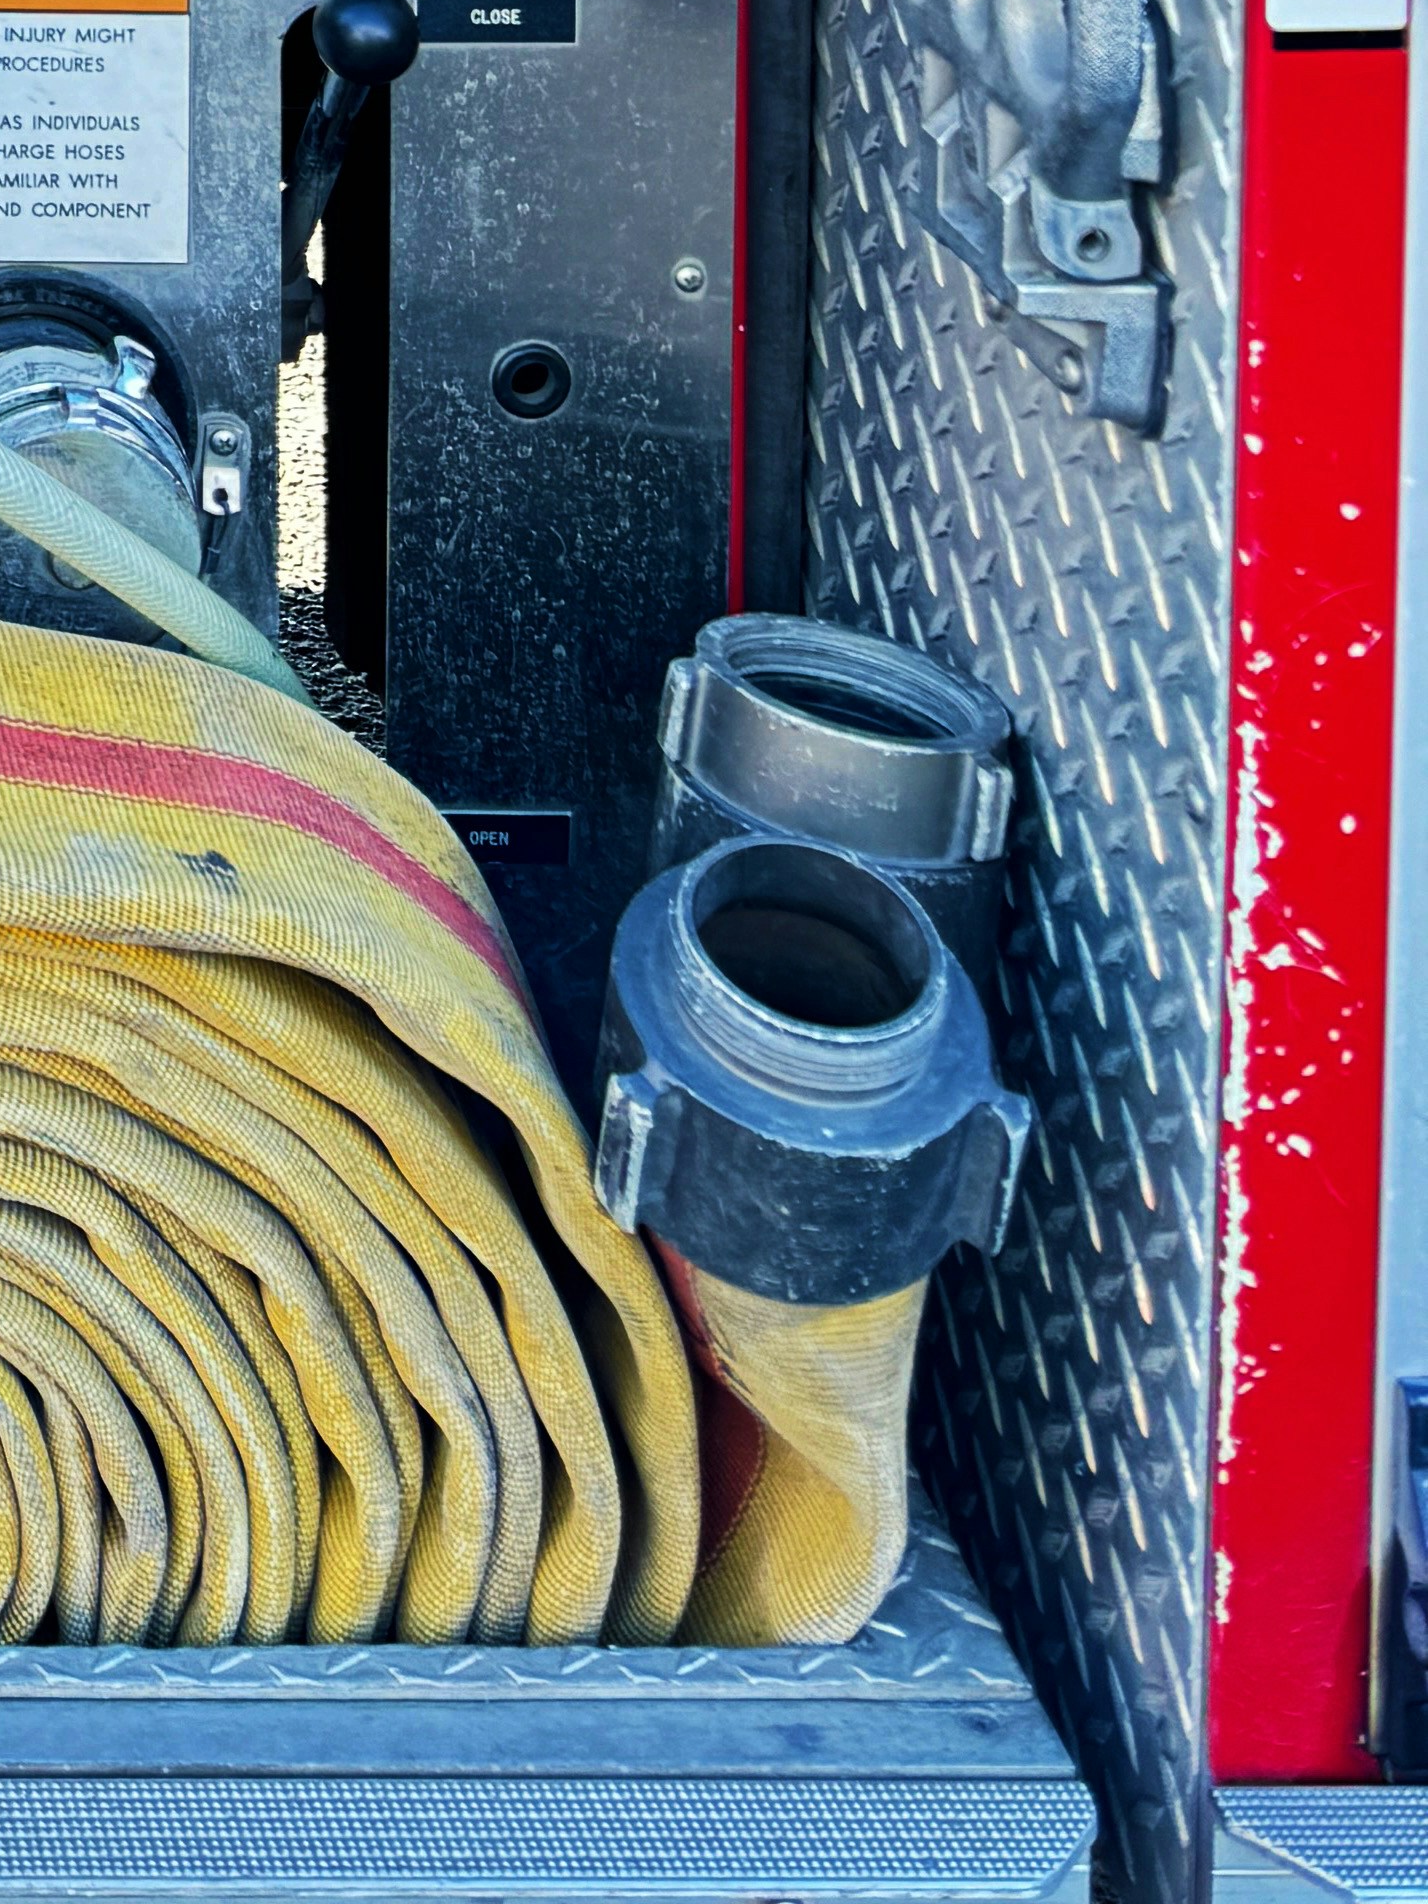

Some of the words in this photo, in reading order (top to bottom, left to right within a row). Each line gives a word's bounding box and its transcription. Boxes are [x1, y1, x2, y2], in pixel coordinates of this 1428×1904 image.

[470, 9, 521, 24] CLOSE
[4, 26, 65, 42] INJURY
[75, 27, 136, 43] MIGHT
[0, 114, 21, 129] AS
[32, 114, 140, 131] INDIVIDUALS
[64, 143, 125, 159] HOSES
[69, 172, 118, 189] WITH
[31, 201, 151, 219] COMPONENT
[469, 830, 510, 846] OPEN
